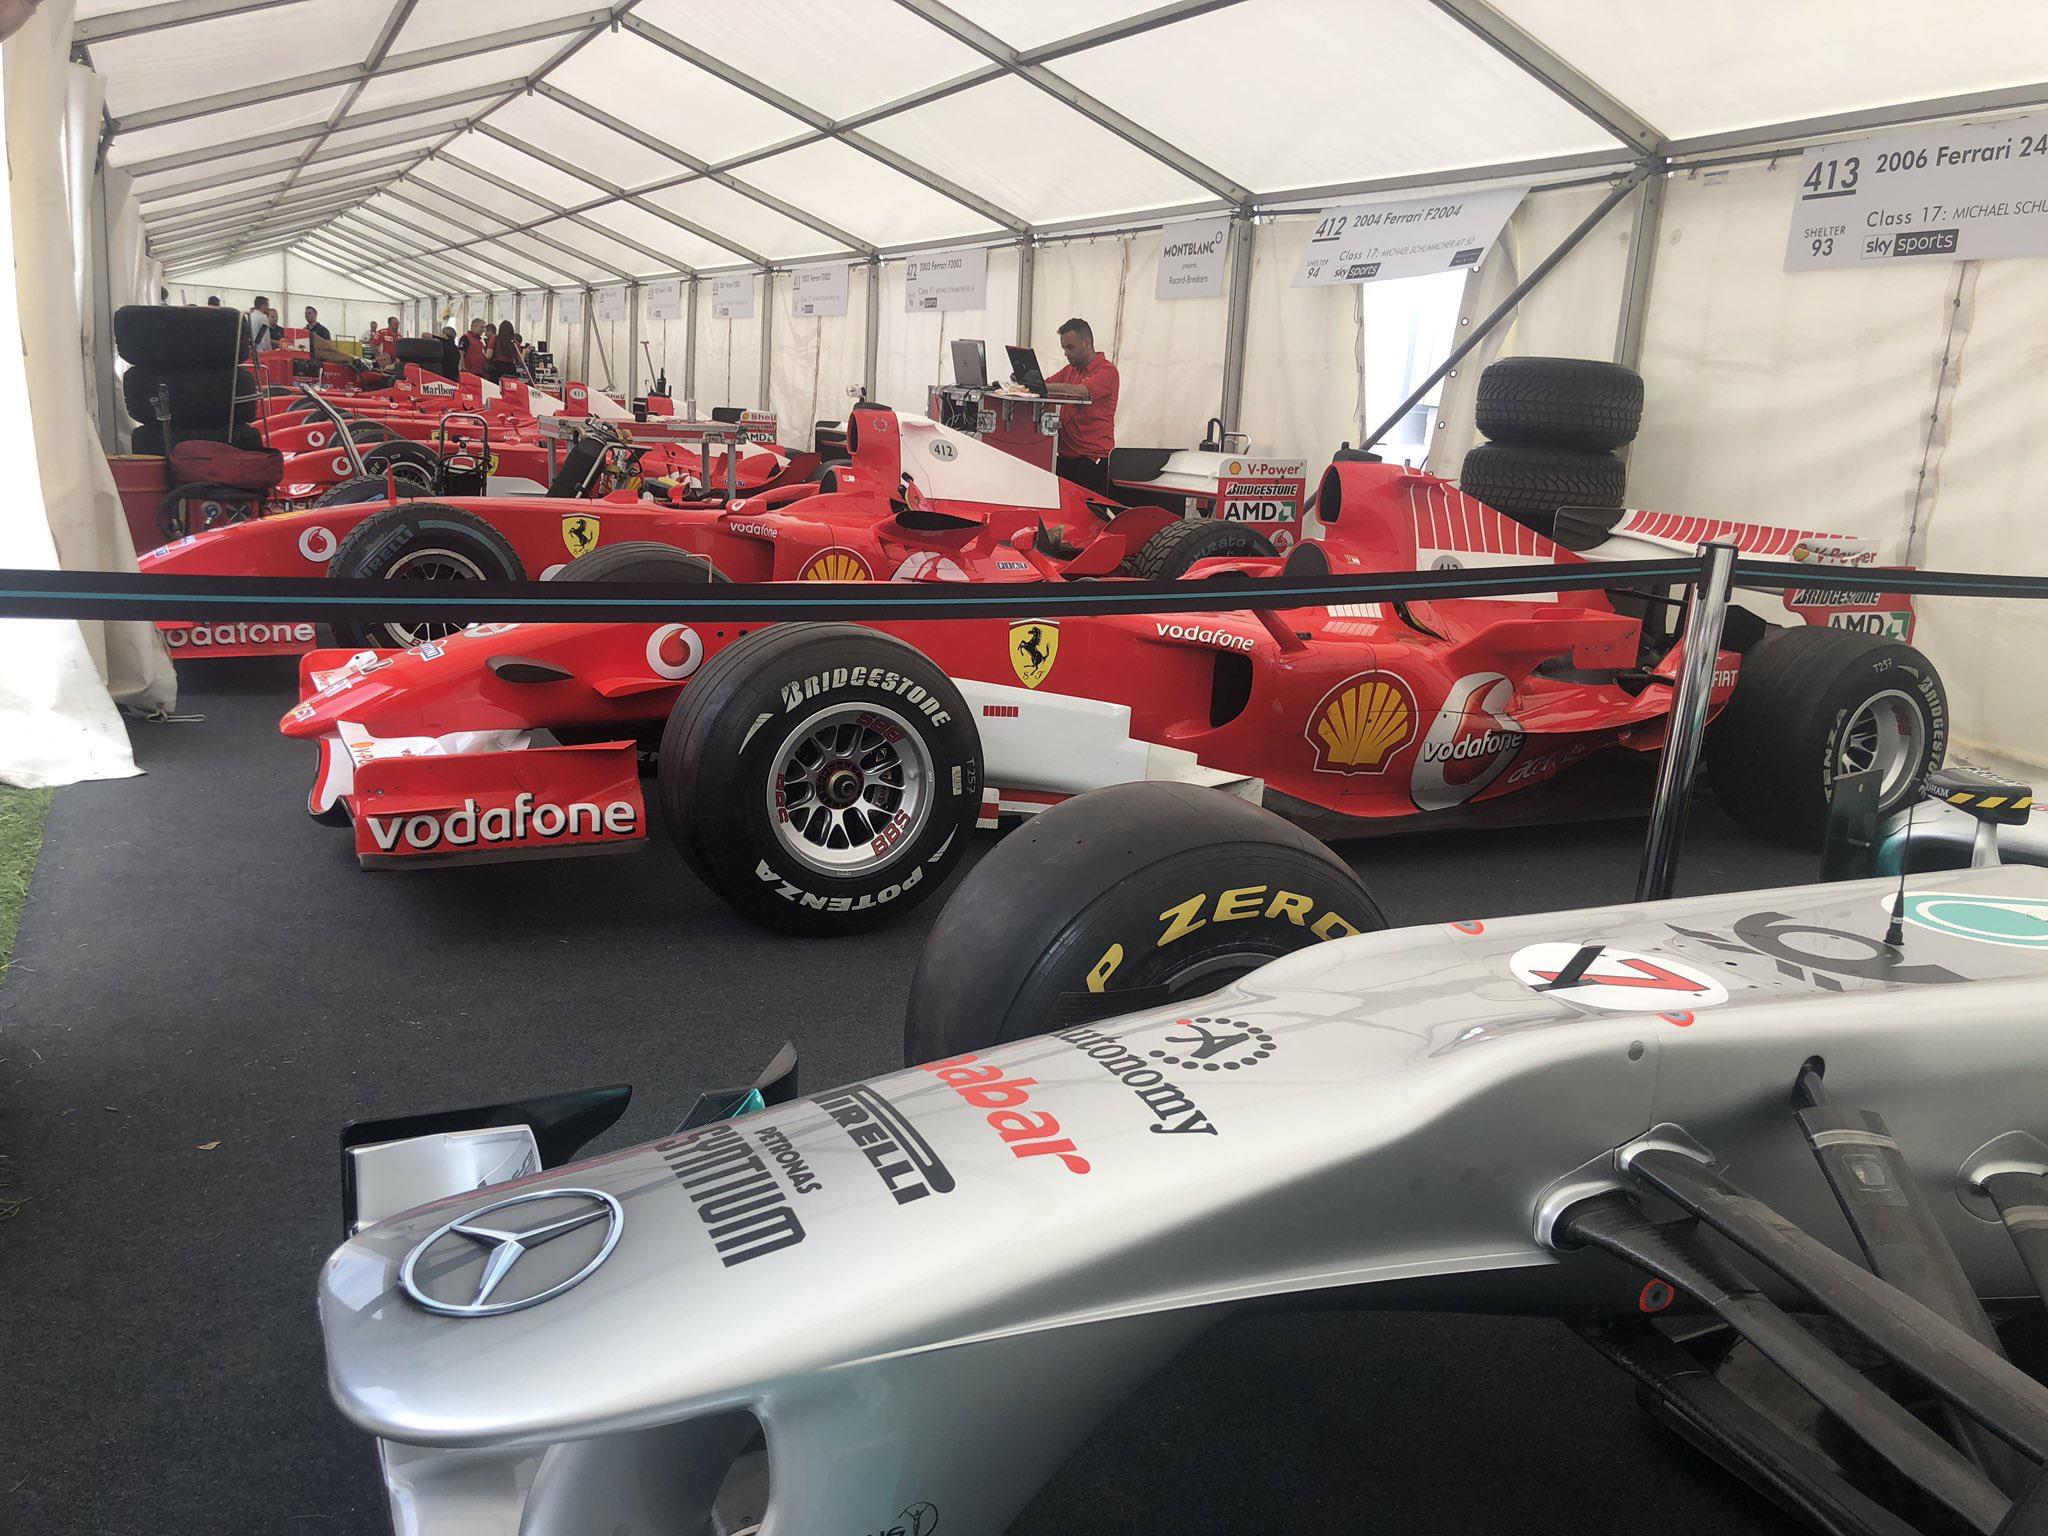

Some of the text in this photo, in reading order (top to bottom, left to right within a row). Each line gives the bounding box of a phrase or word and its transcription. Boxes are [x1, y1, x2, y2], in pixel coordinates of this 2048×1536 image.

[1875, 149, 1928, 173] 2006
[1936, 137, 2012, 166] Ferrari
[1803, 157, 1860, 192] 413
[1315, 216, 1347, 237] 412
[1353, 204, 1463, 227] 2004 Ferrari F2004
[1867, 210, 1912, 227] Class
[1922, 206, 1947, 222] 17:
[1953, 203, 2010, 219] MICHAEL
[1804, 225, 1846, 238] SHELTER
[1163, 240, 1215, 258] MONTBLANC
[1339, 249, 1362, 261] Class
[1812, 239, 1833, 257] 93
[1866, 233, 1954, 255] sky sports
[1307, 267, 1320, 279] 94
[1334, 267, 1347, 278] sky
[422, 384, 454, 395] Marlbor
[933, 442, 954, 457] 412
[1247, 463, 1300, 476] V-Power
[1226, 482, 1298, 496] BRIDGESTONE
[1225, 502, 1277, 521] AMD
[730, 521, 778, 539] vodafone
[166, 622, 316, 648] odafone
[1155, 621, 1255, 651] vodafone
[1872, 658, 1893, 673] T257
[1712, 670, 1738, 687] FIAT
[781, 666, 951, 728] BRIDGESTONE
[1917, 676, 1944, 784] BRIDGESTO
[1423, 728, 1523, 761] vodafone
[966, 756, 977, 794] T257
[366, 792, 637, 851] vodafone
[870, 808, 912, 857] BBS
[755, 858, 924, 912] POTENZA
[1086, 885, 1362, 993] P ZERO
[1052, 1028, 1218, 1136] utonomy
[810, 1084, 956, 1206] PIRELLI
[754, 1126, 823, 1194] PETRONAS
